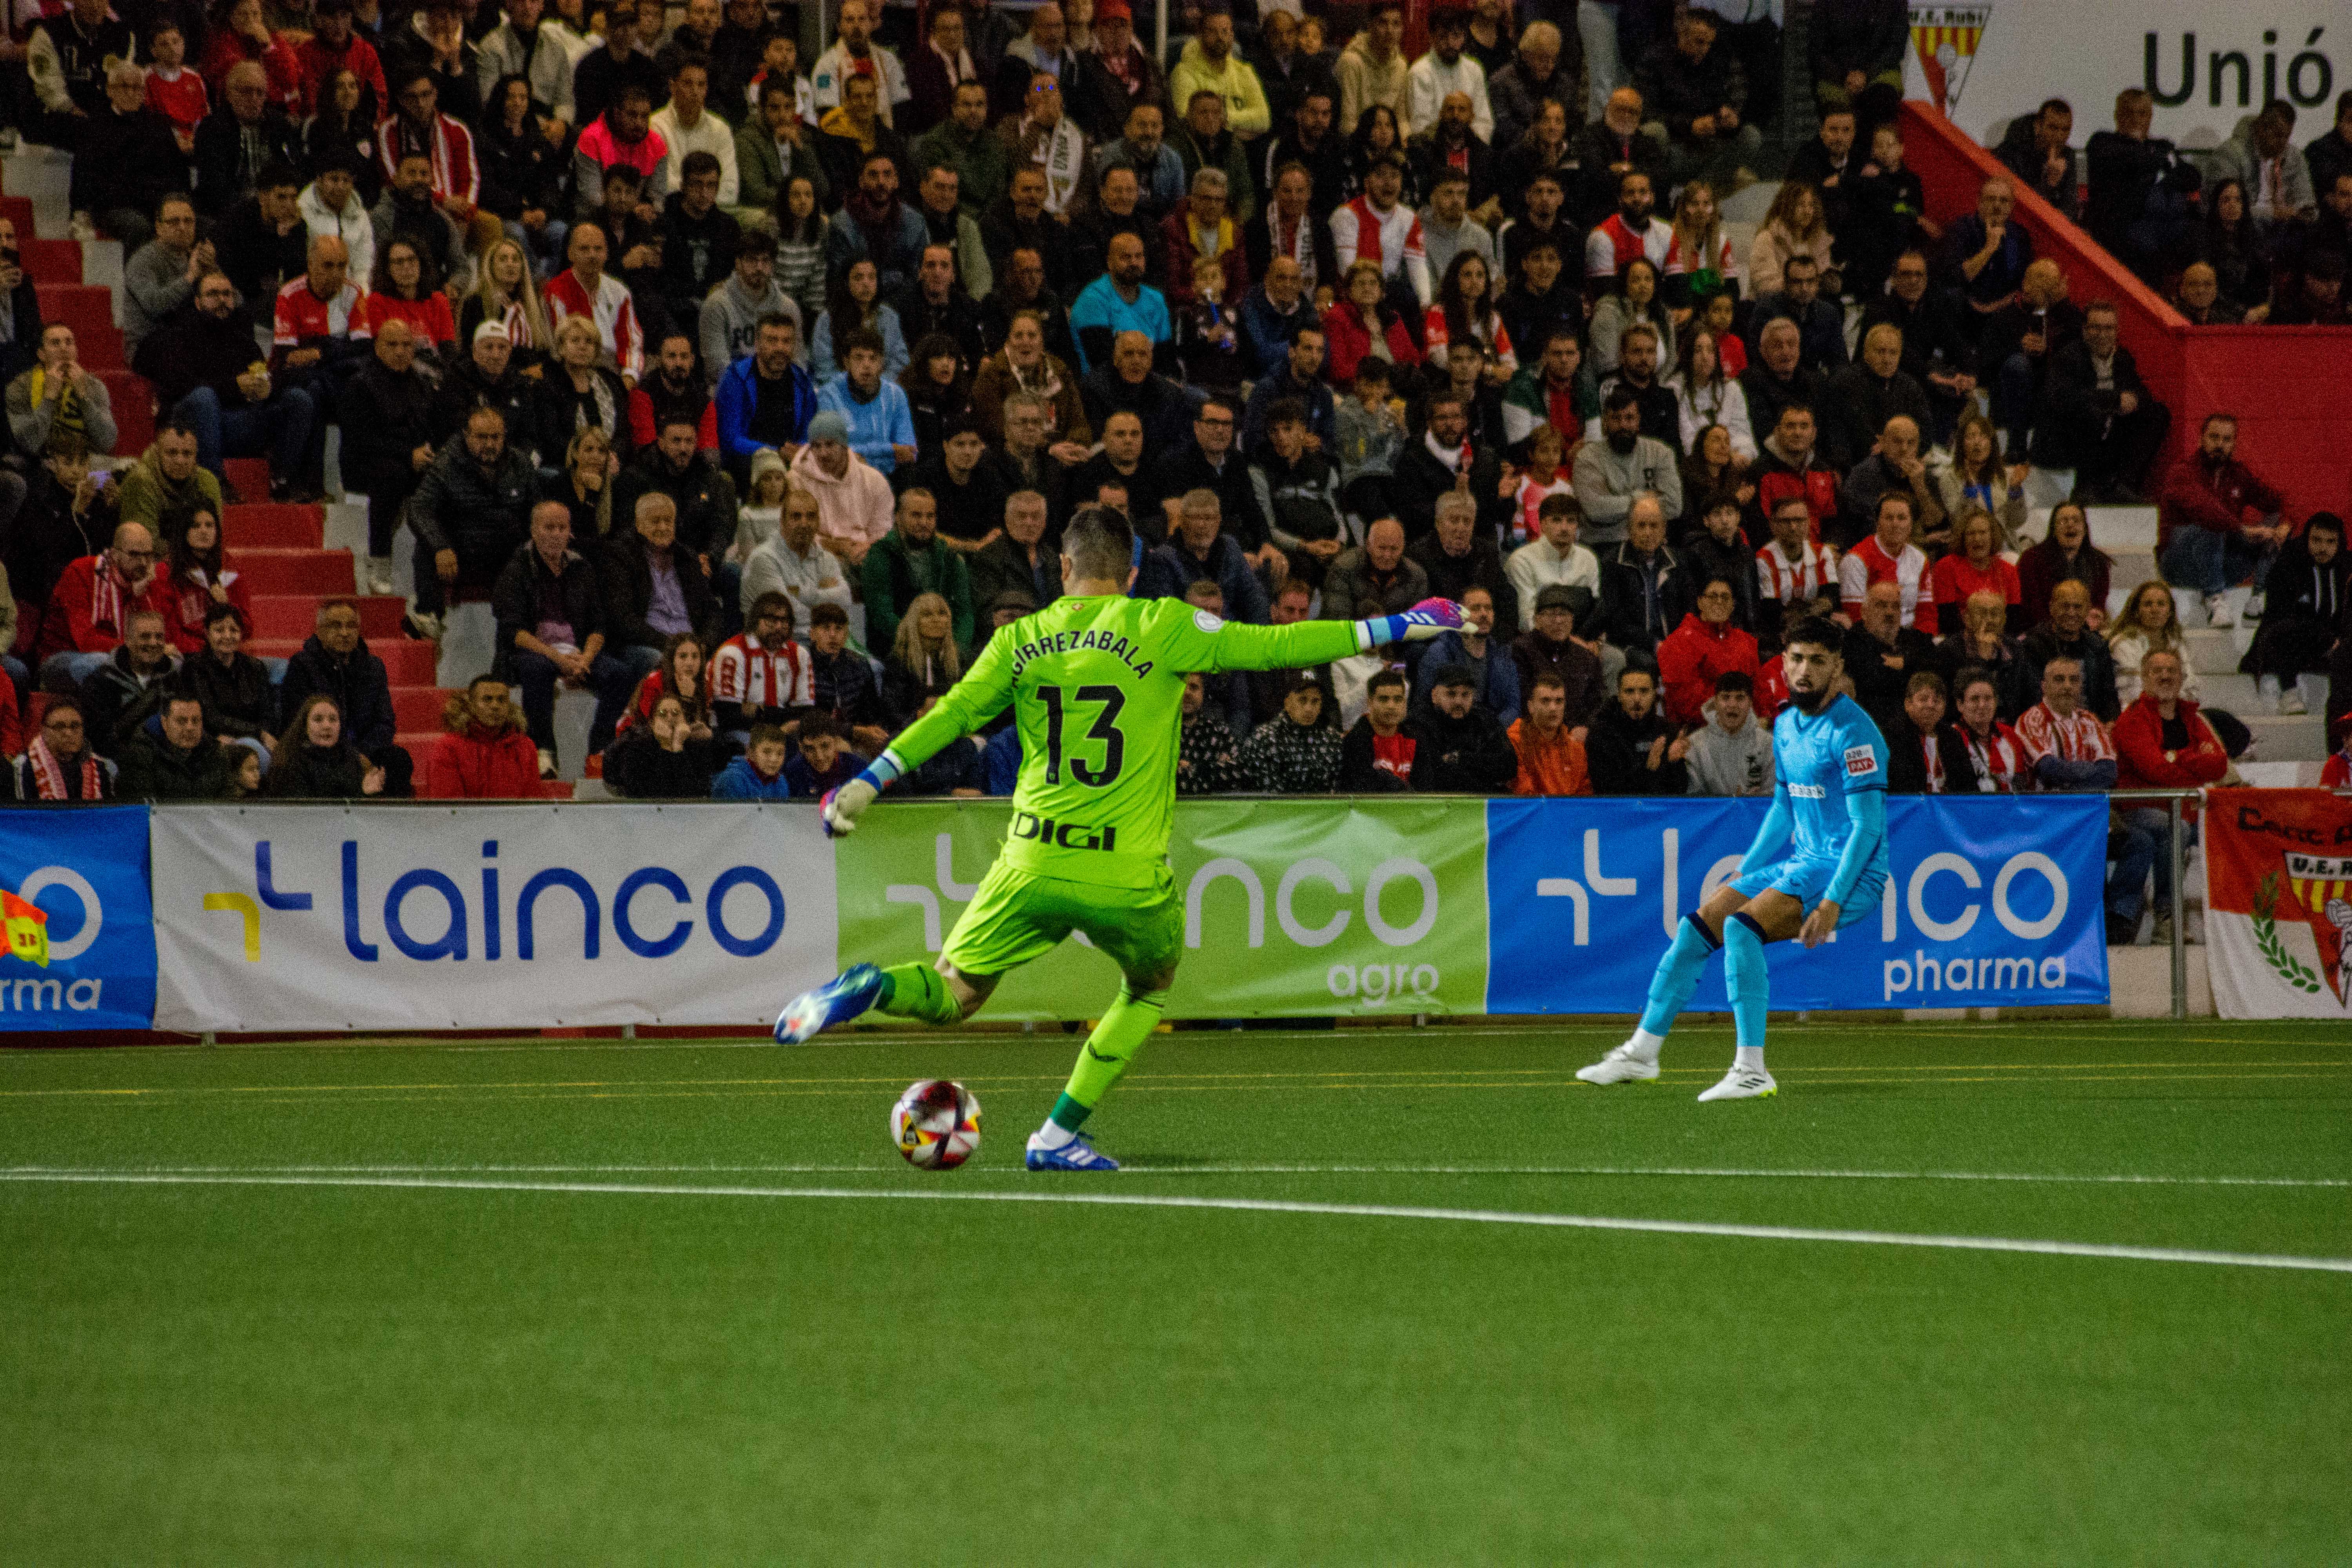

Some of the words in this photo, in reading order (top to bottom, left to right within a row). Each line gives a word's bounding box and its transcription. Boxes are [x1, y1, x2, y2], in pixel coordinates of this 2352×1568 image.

[2143, 27, 2333, 107] Unió
[1036, 684, 1126, 788] 13
[1014, 812, 1116, 851] DIGI
[2292, 858, 2334, 875] U.E.
[341, 840, 785, 962] lainco
[1327, 964, 1439, 1007] agro
[1884, 949, 2066, 1001] pharma
